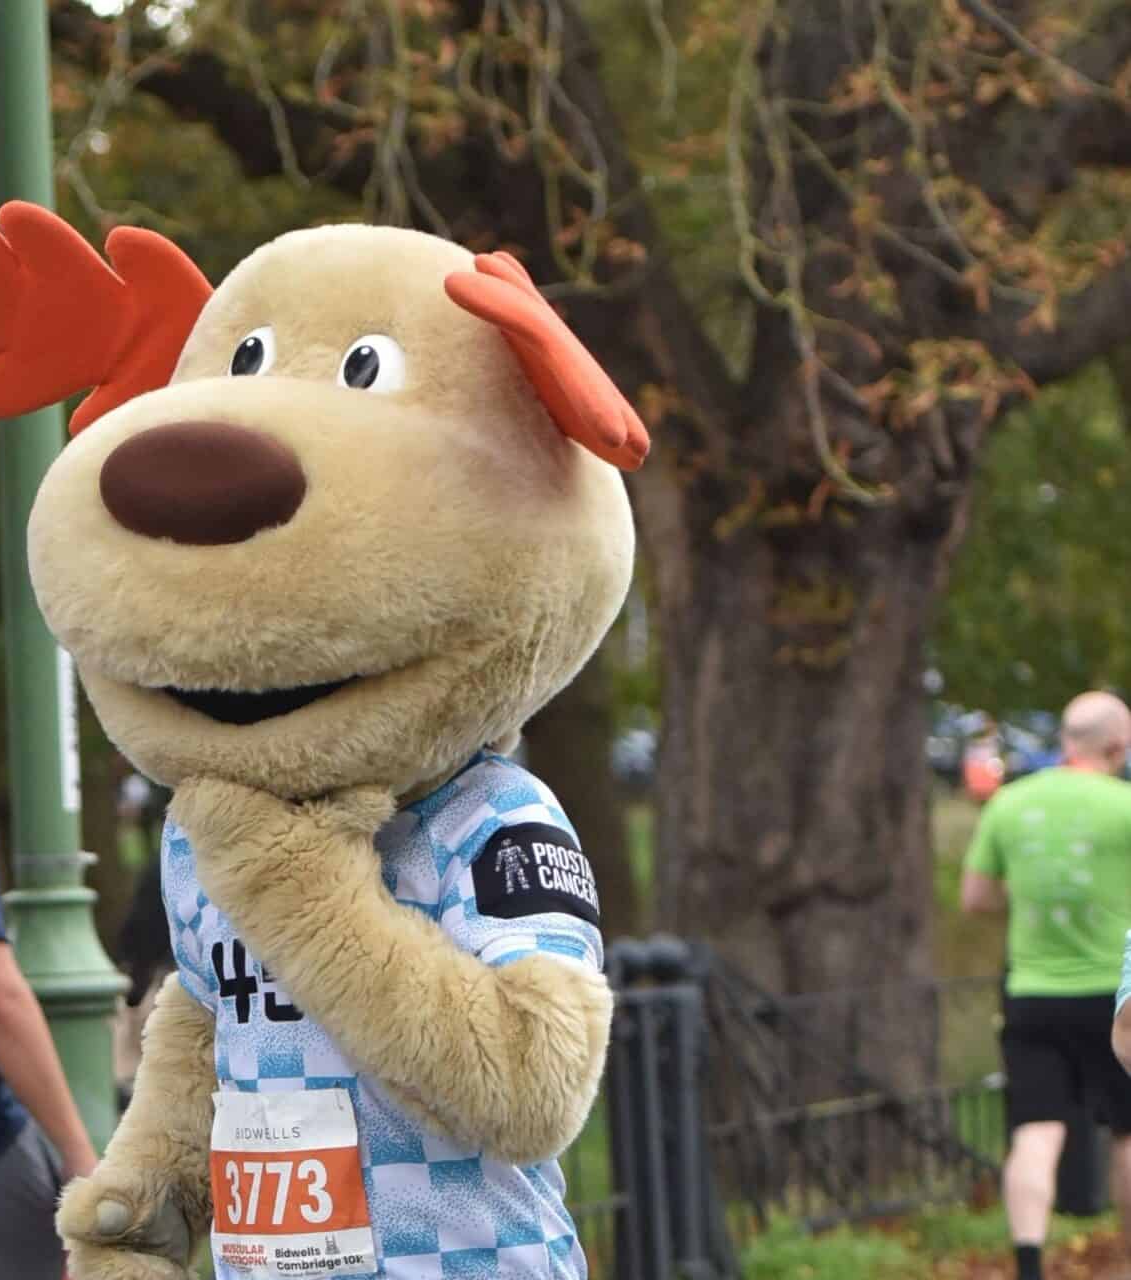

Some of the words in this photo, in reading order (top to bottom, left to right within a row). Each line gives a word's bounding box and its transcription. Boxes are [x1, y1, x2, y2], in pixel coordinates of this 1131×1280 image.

[235, 1126, 301, 1140] BIDWELLS
[225, 1159, 334, 1225] 3773
[275, 1247, 321, 1258] Bidwells
[277, 1259, 341, 1271] Cambridge
